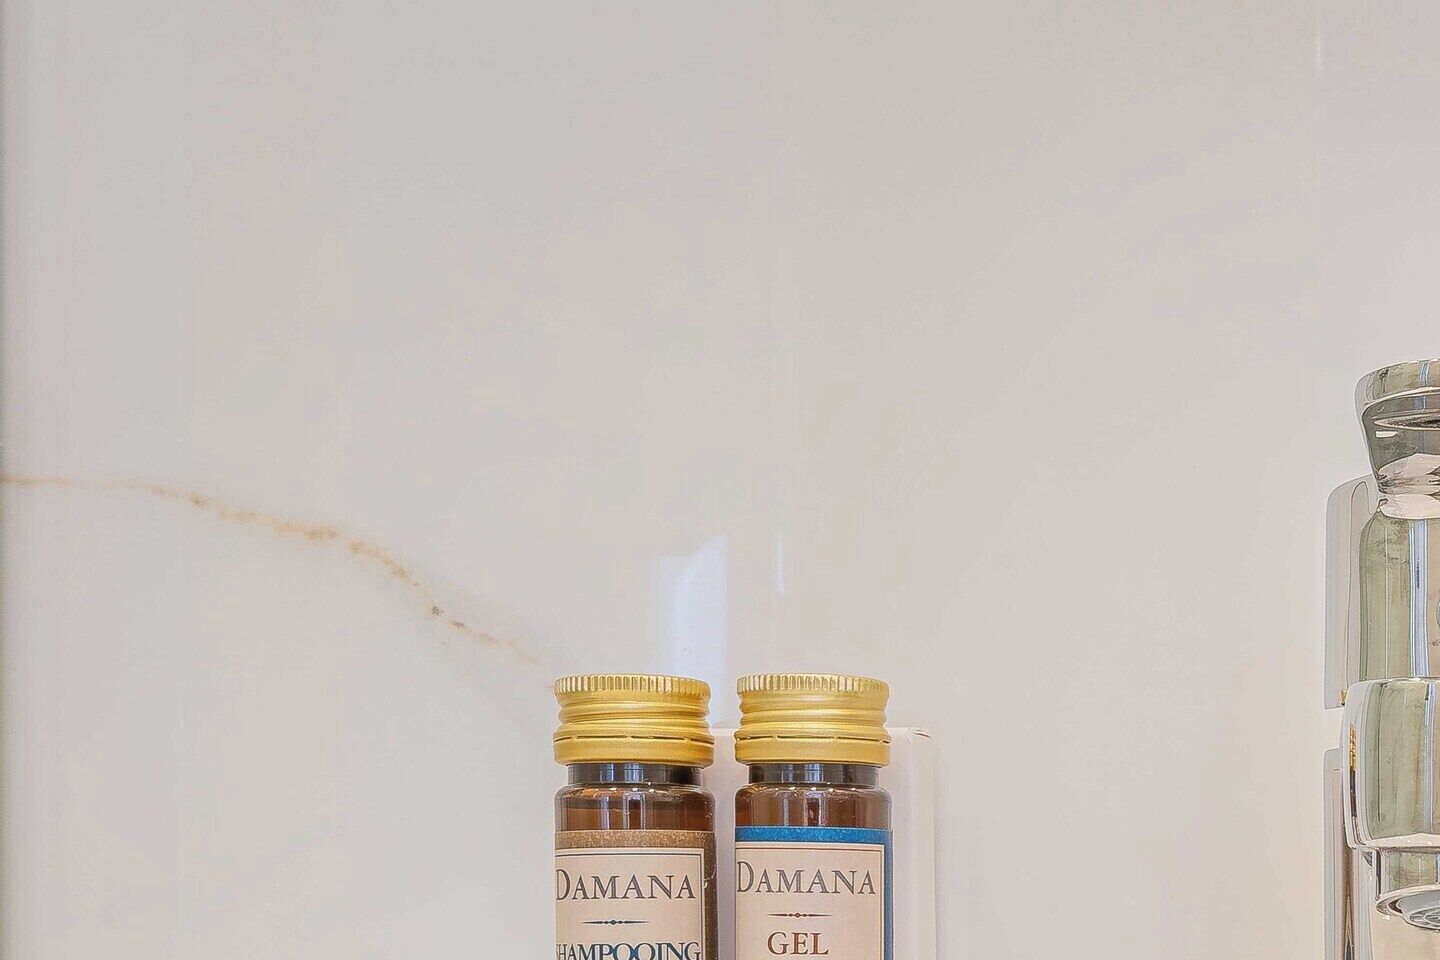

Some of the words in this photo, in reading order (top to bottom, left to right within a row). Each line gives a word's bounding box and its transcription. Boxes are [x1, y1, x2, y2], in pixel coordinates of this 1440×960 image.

[555, 868, 696, 901] DAMANA
[736, 860, 877, 895] DAMANA
[767, 931, 829, 956] GEL
